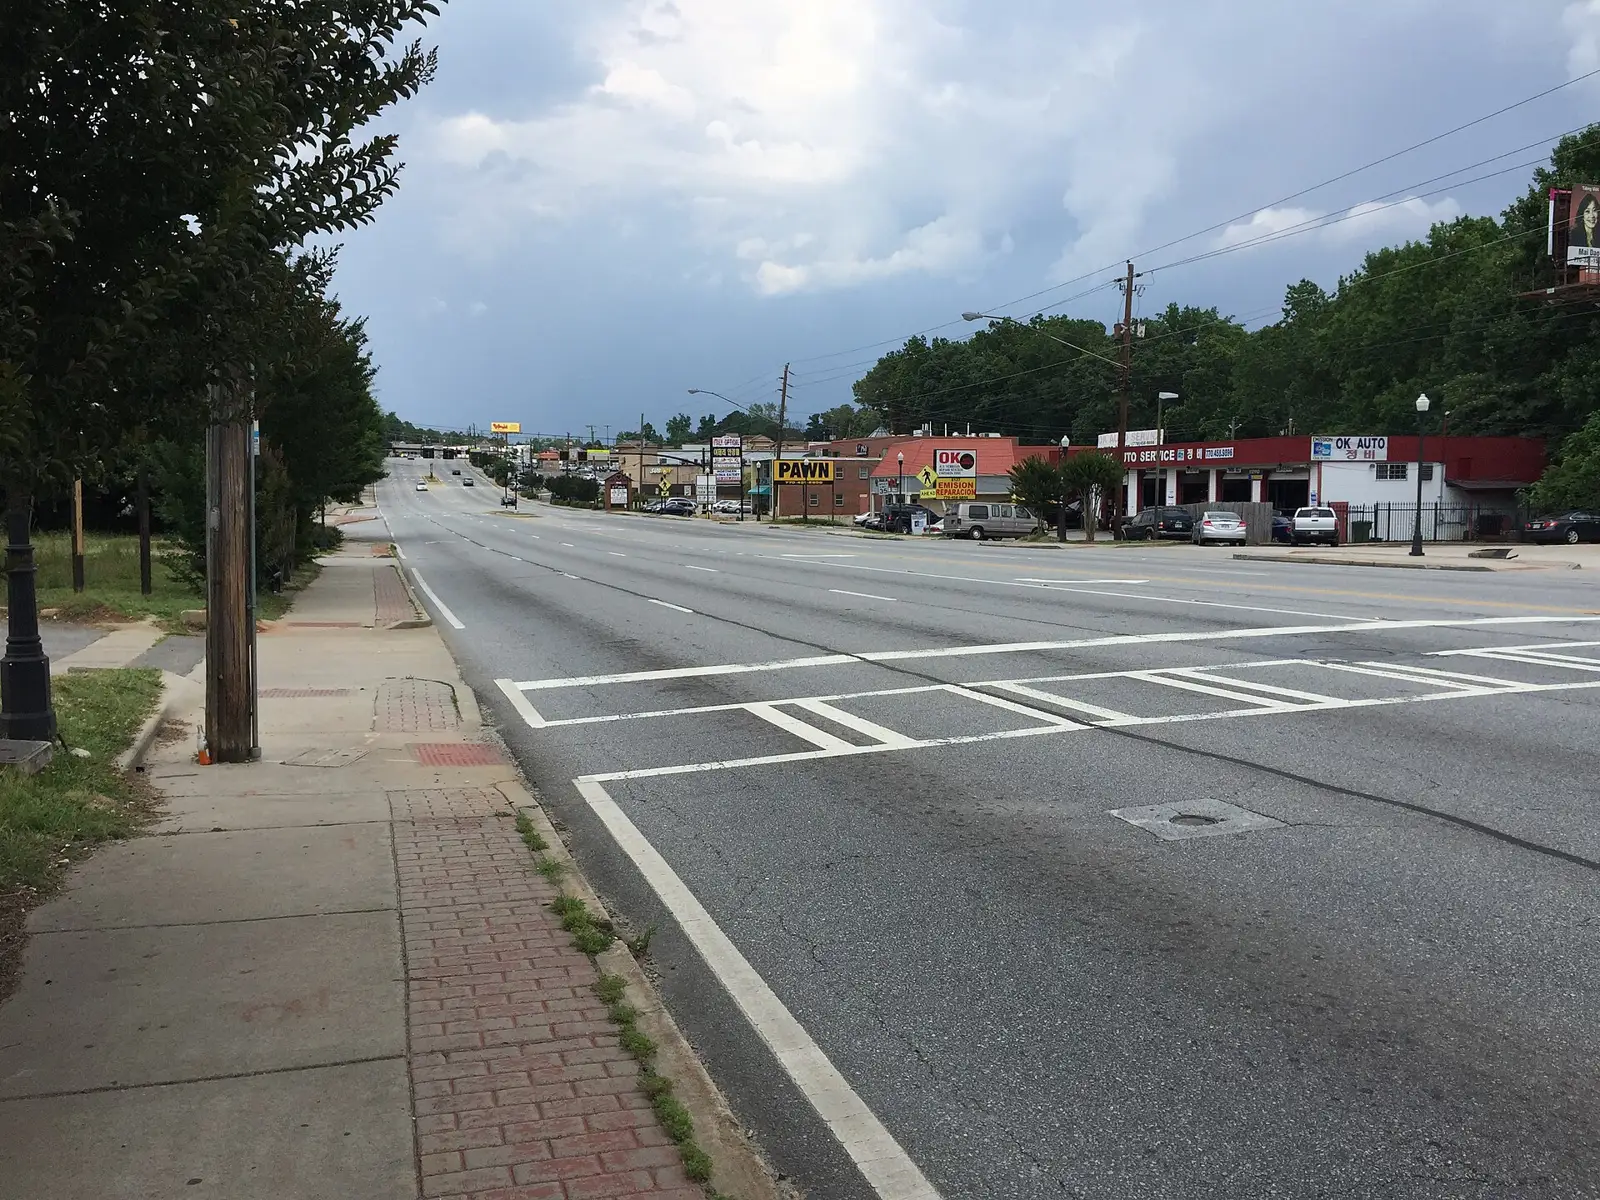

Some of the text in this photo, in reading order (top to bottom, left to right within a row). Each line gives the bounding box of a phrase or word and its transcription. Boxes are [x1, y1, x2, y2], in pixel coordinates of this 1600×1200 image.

[1579, 248, 1589, 256] Mai
[1335, 437, 1386, 449] OK AUTO
[939, 451, 961, 464] OK
[1123, 452, 1137, 462] UTO
[778, 462, 829, 478] PAWN
[938, 481, 974, 489] EMISION
